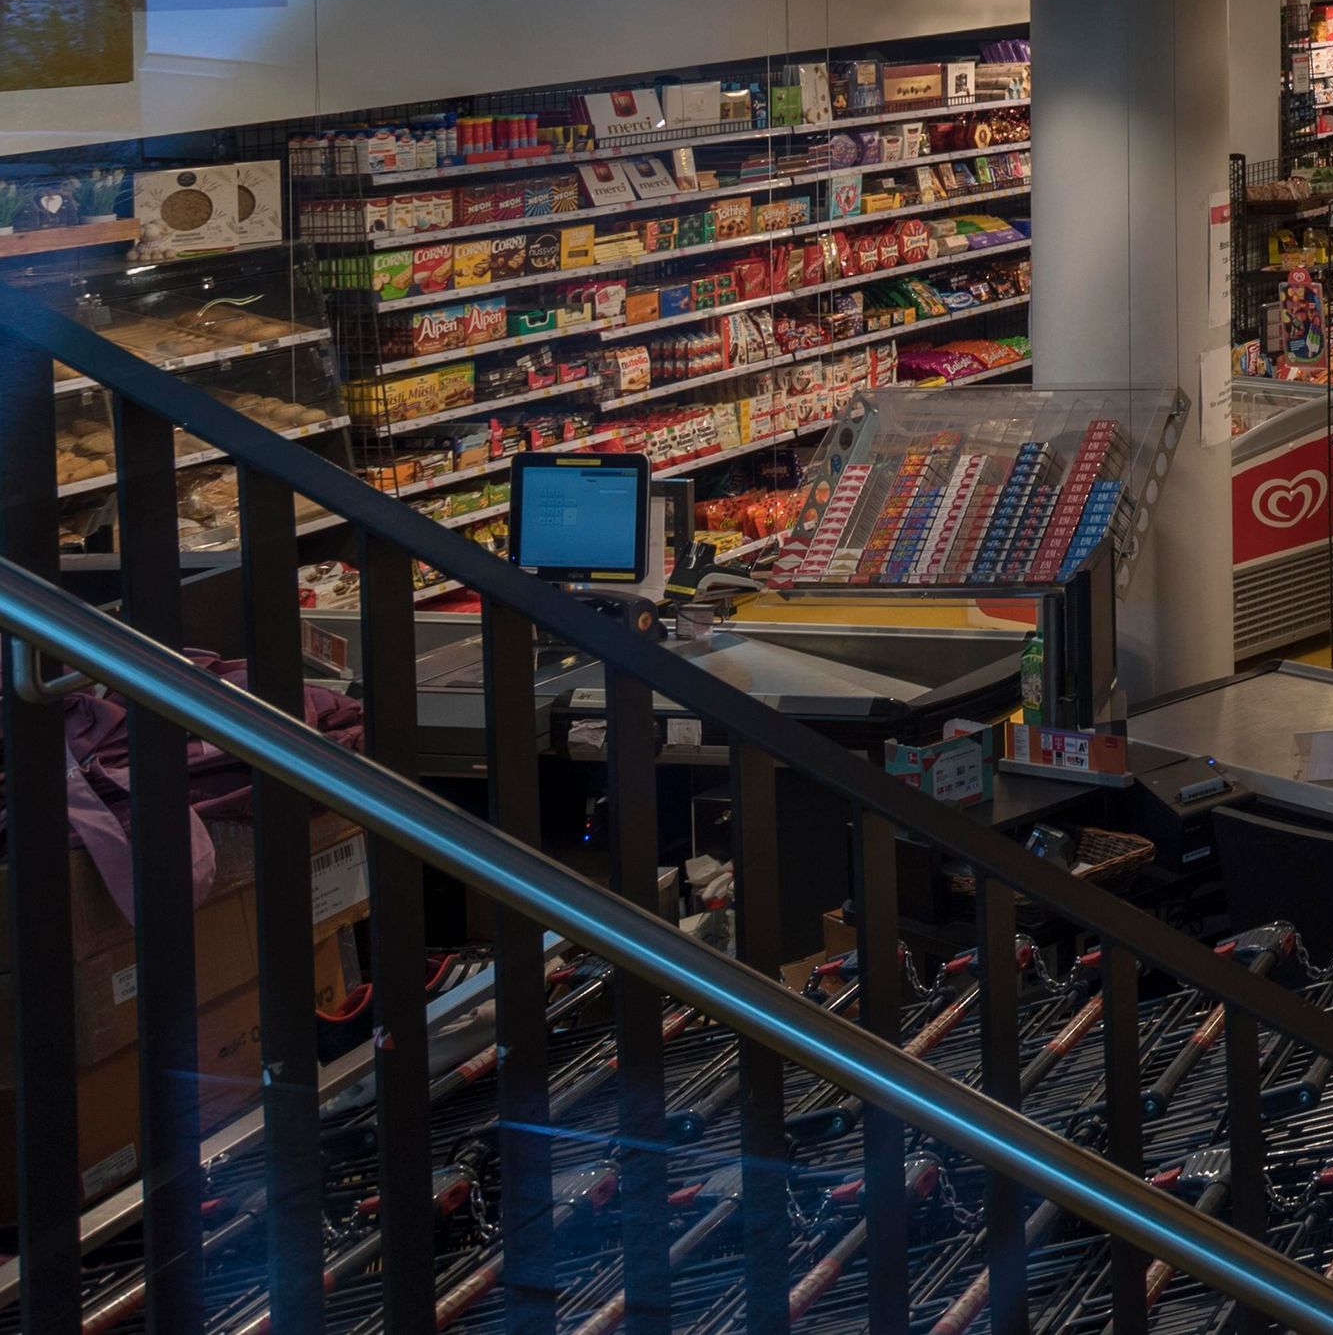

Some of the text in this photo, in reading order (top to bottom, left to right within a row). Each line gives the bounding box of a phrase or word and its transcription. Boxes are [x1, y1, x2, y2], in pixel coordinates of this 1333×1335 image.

[607, 116, 653, 135] merci
[594, 181, 626, 196] merci
[638, 177, 671, 190] merci
[716, 202, 750, 220] Toffifee
[413, 243, 452, 265] CORNY
[454, 239, 492, 261] CORNY
[491, 233, 528, 255] CORNY
[373, 249, 412, 271] CORNY
[417, 317, 458, 343] Alpen
[467, 306, 503, 334] Alpen
[620, 355, 649, 369] nutella
[408, 382, 438, 401] Müsli
